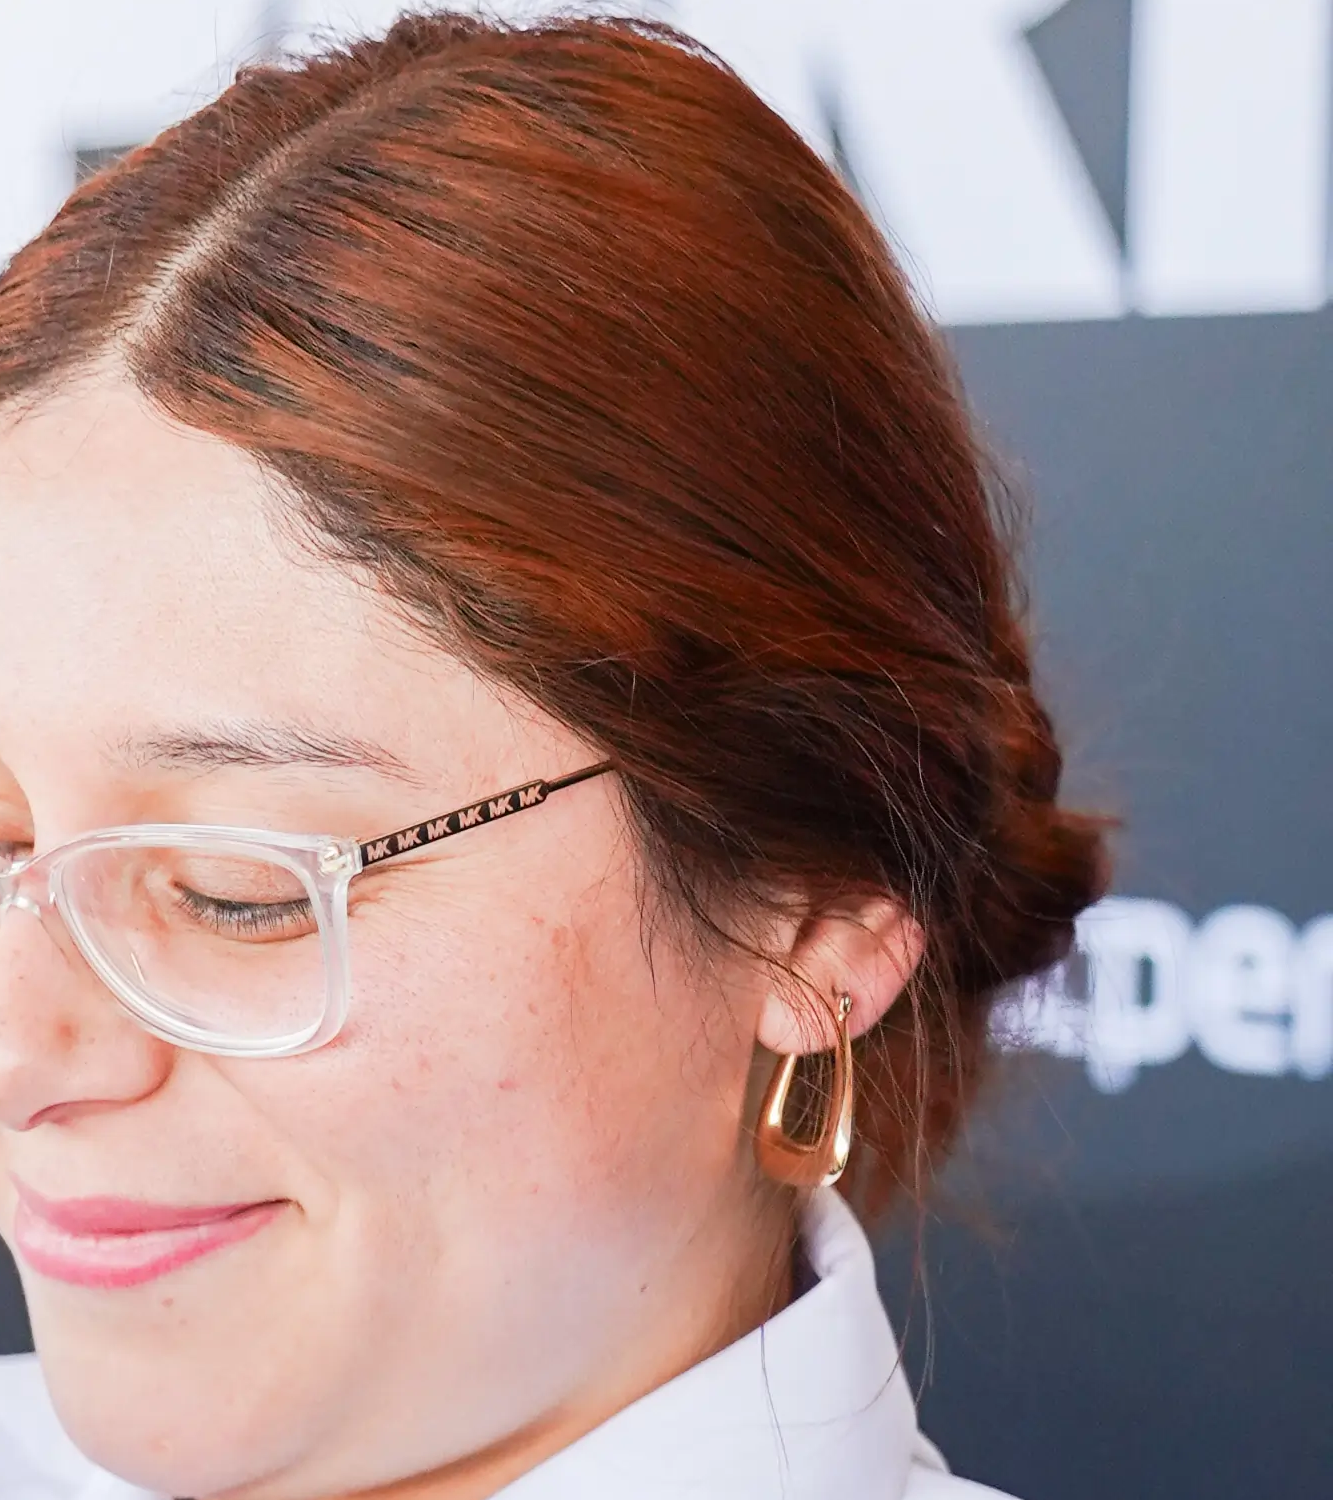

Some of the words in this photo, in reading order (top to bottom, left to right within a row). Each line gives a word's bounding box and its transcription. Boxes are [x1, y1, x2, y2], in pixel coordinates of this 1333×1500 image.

[366, 838, 392, 862] MK
[397, 827, 421, 851] MK
[427, 817, 452, 841] MK
[458, 805, 483, 829] MK
[488, 794, 514, 818] MK
[518, 784, 544, 808] MK
